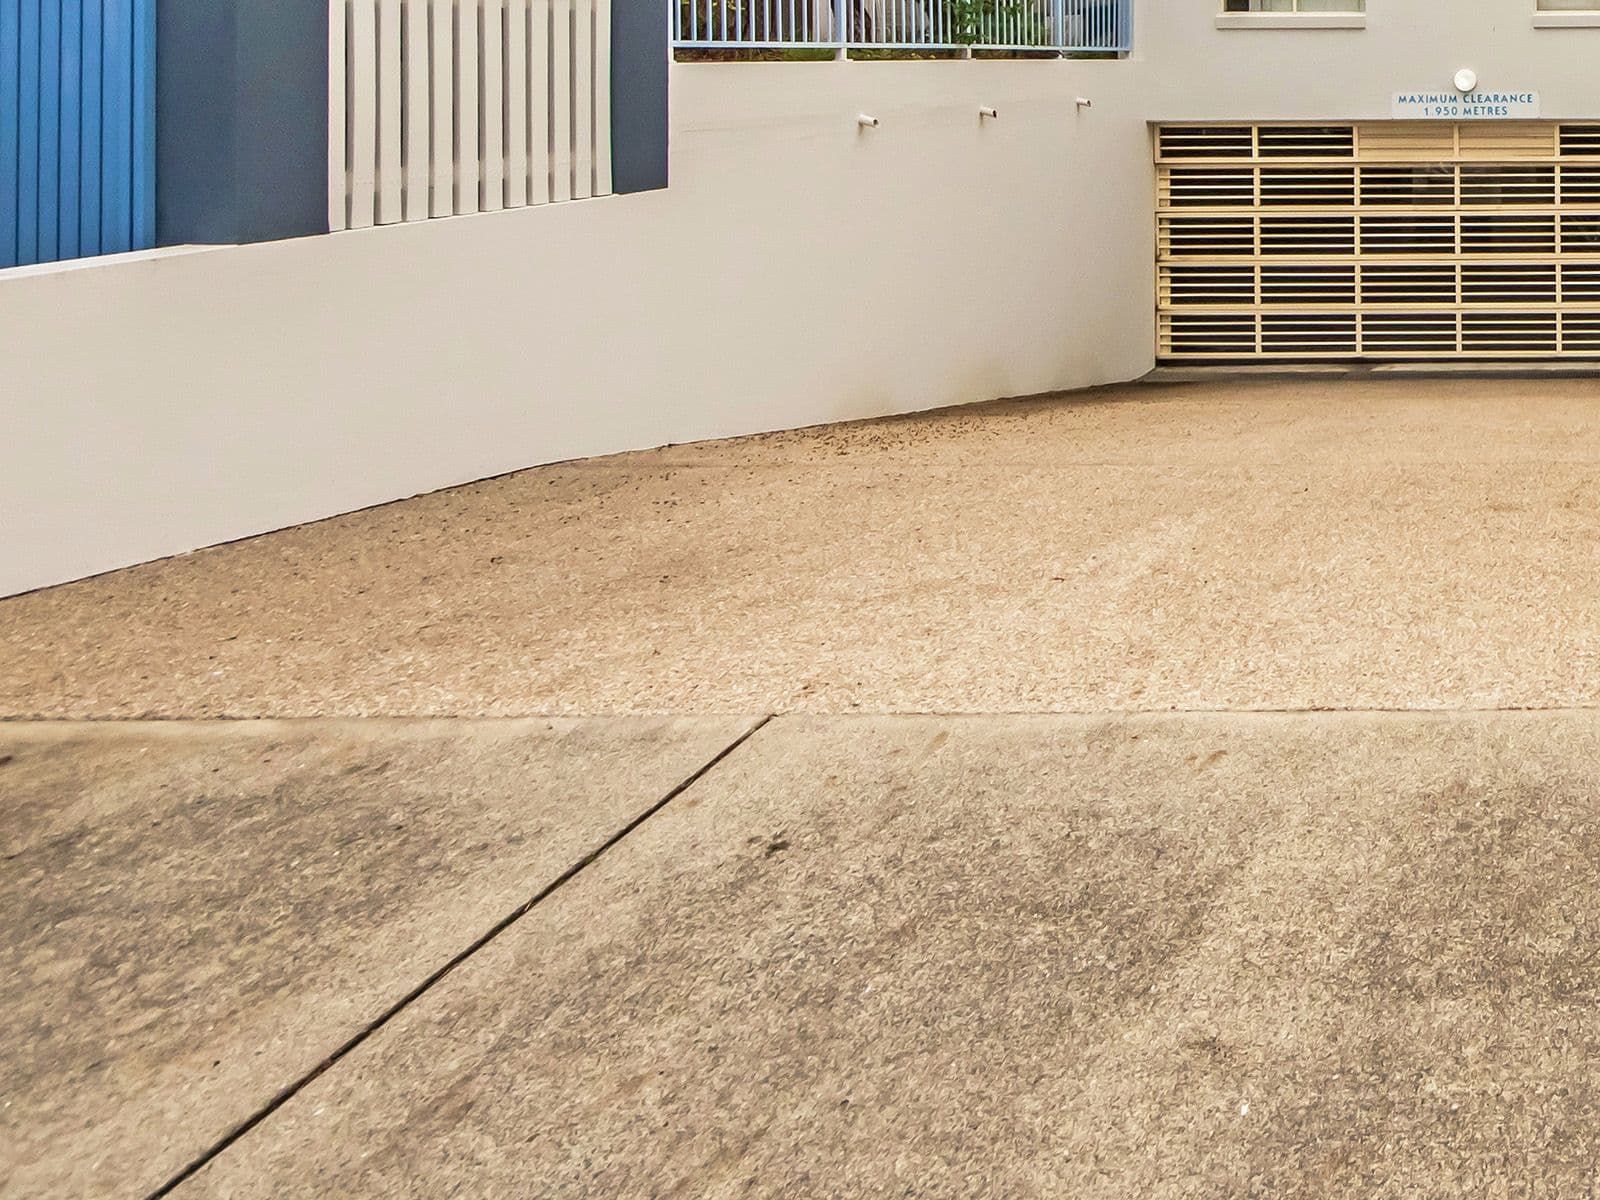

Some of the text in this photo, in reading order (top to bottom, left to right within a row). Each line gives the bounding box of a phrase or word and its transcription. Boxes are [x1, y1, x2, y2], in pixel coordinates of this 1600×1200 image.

[1398, 93, 1533, 104] MAXIMUM CLEARANCE
[1463, 106, 1508, 116] METRES
